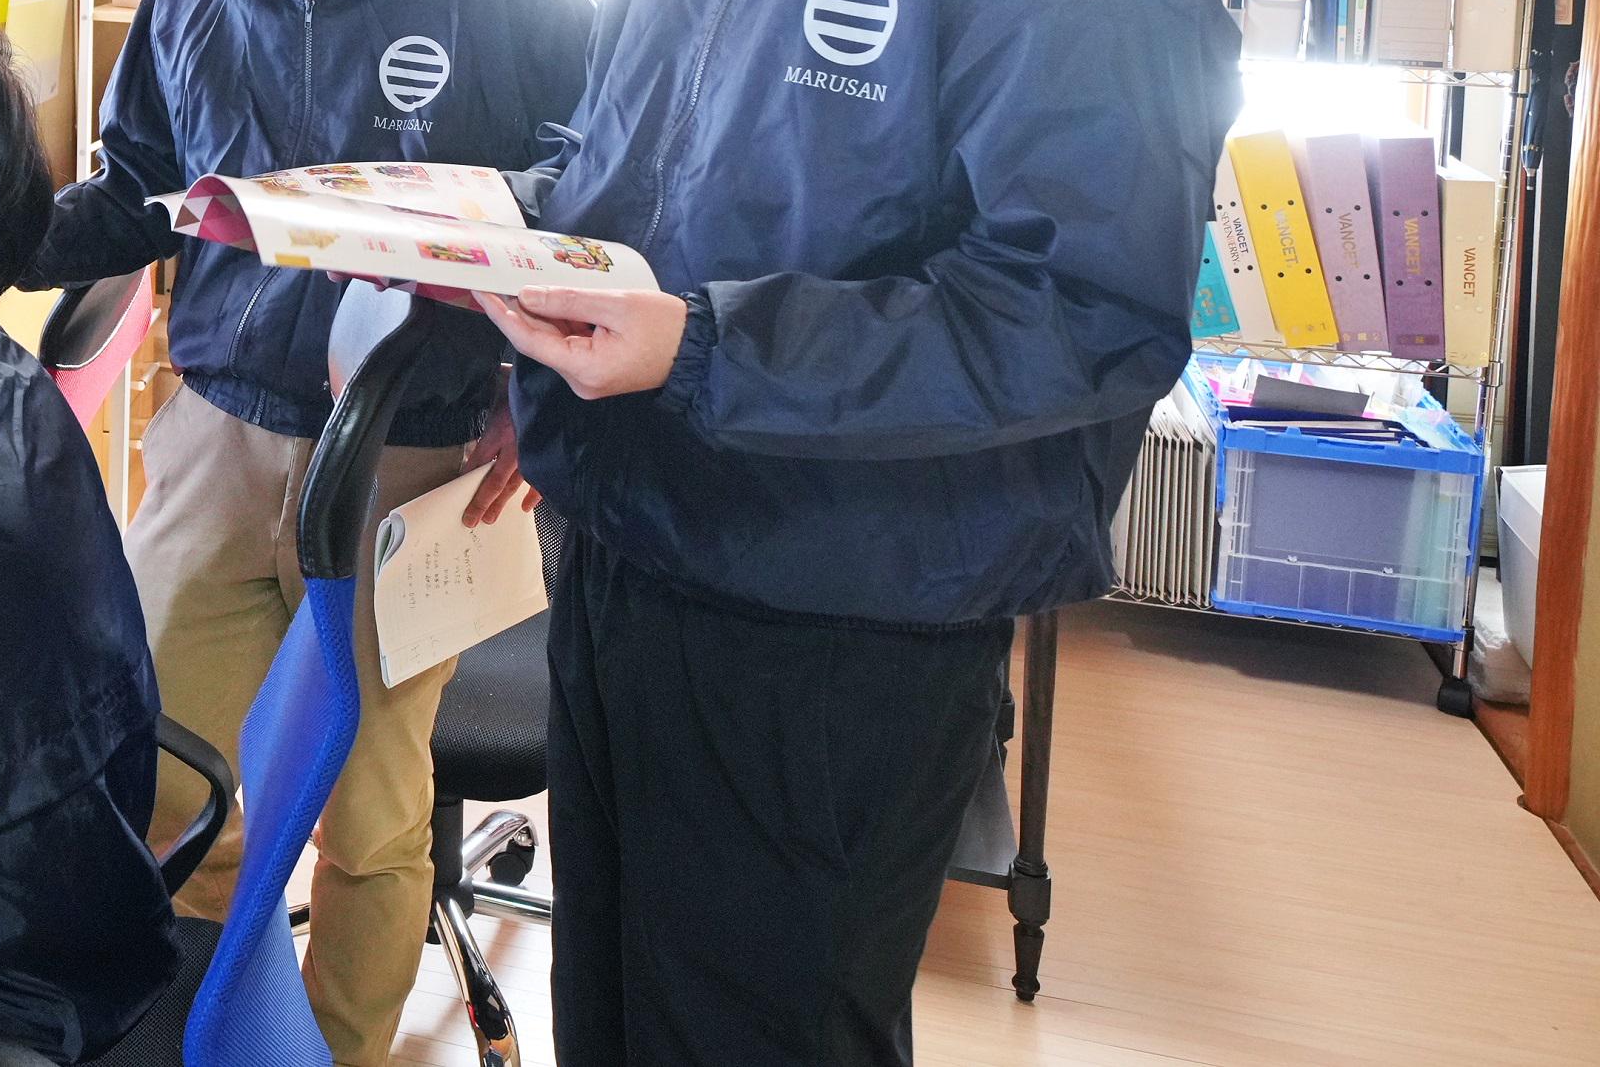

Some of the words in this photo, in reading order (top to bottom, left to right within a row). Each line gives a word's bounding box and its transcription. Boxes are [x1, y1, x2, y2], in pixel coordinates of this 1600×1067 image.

[783, 65, 888, 102] MARUSAN
[373, 116, 433, 133] MARUSAN
[1232, 217, 1249, 254] VANCET
[1274, 208, 1299, 265] VANCET
[1338, 212, 1360, 269] VANCET
[1404, 218, 1421, 276] VANCET
[1463, 247, 1477, 298] VANCET
